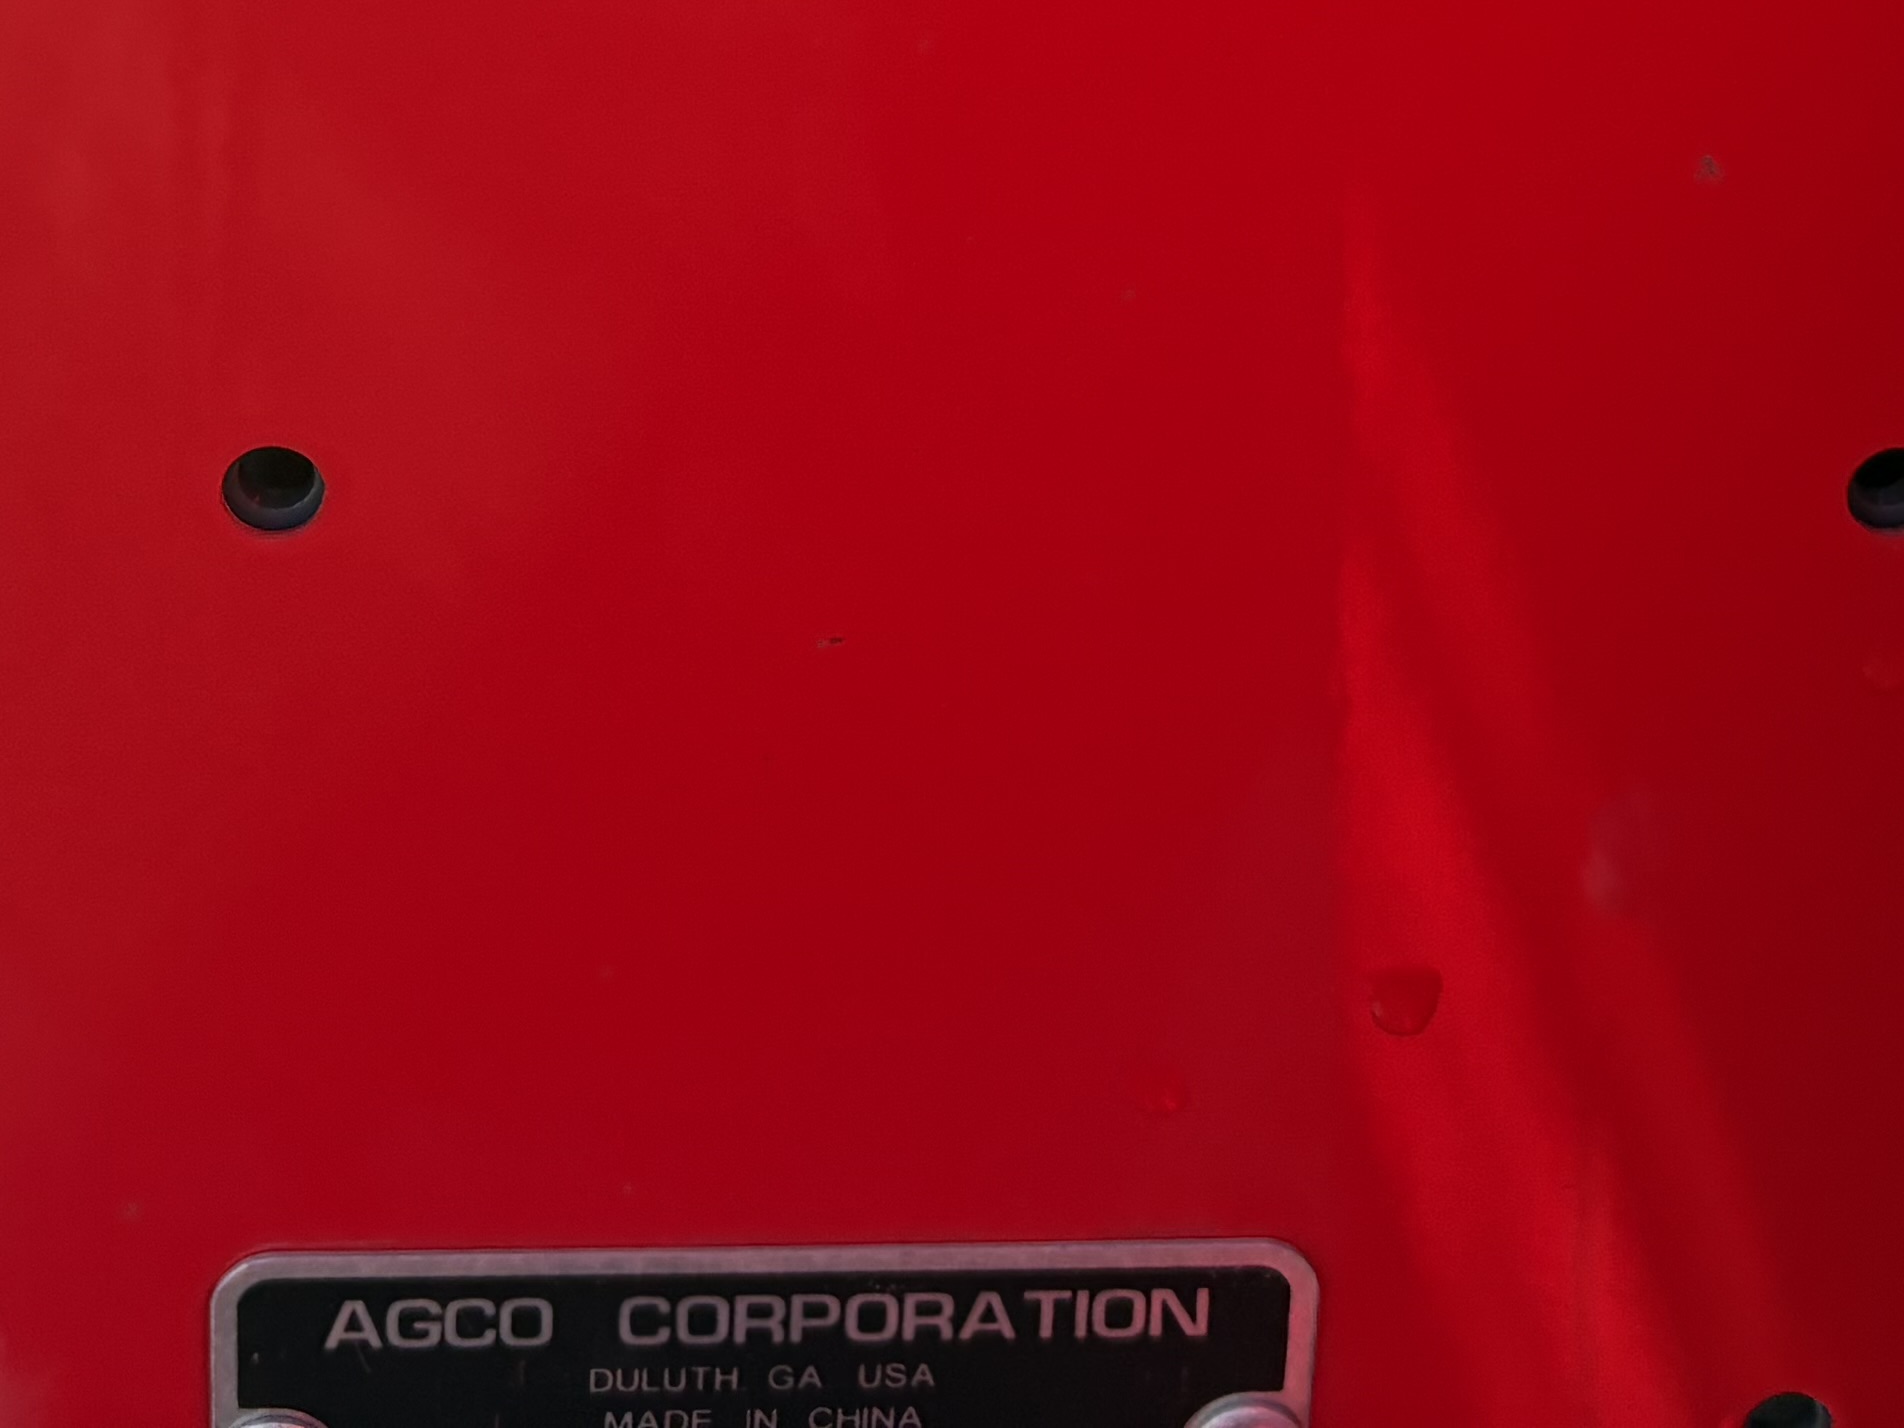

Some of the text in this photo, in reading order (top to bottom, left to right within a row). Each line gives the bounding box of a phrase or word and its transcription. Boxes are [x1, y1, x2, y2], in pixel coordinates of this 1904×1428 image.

[324, 1287, 1210, 1350] AGCO CORPORATION
[589, 1362, 936, 1393] DULUTH GA USA
[604, 1406, 923, 1428] MADE IN CHINA
